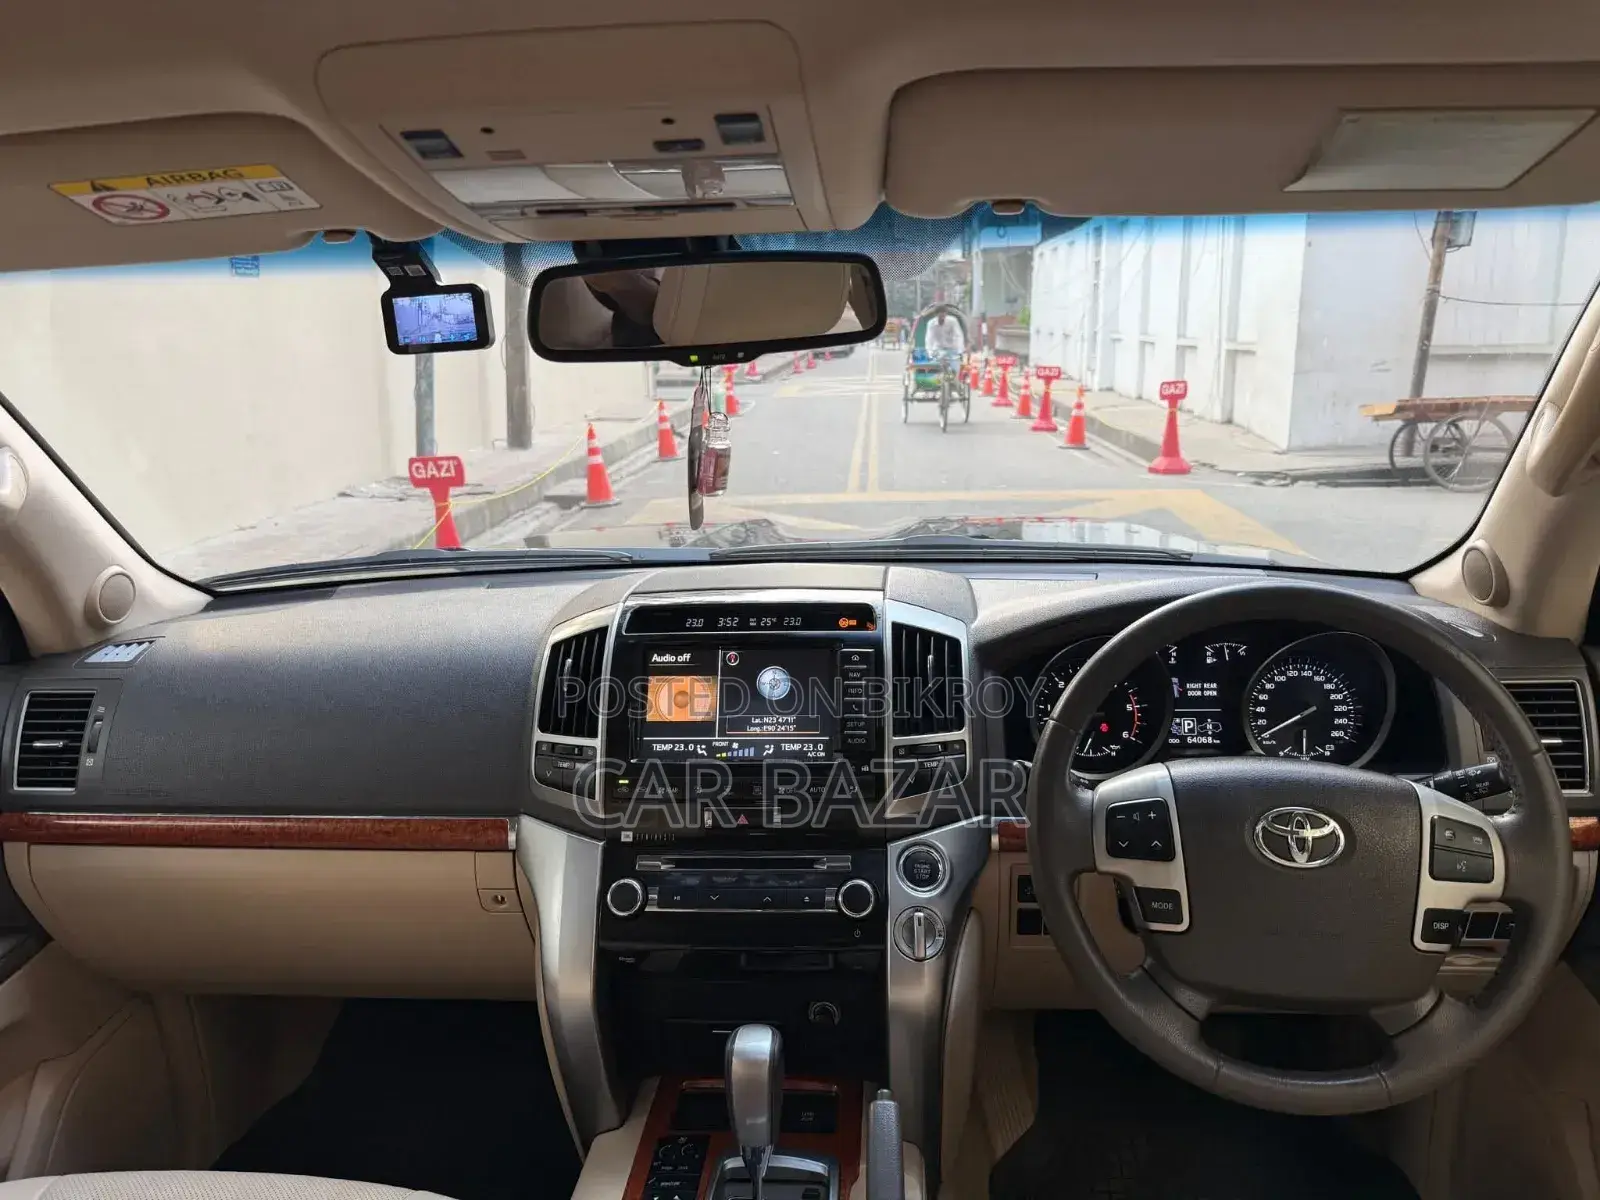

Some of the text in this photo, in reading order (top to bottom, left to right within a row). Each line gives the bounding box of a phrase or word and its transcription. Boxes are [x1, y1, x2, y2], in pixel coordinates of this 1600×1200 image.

[146, 168, 245, 188] AIRBAG
[411, 460, 457, 479] GAZI
[685, 618, 704, 627] 23.0
[717, 617, 739, 627] 3:52
[783, 617, 802, 626] 23.0
[652, 653, 692, 662] Audio off
[1184, 720, 1194, 733] P
[1187, 736, 1213, 744] 64068
[1151, 901, 1173, 910] MODE
[1433, 921, 1450, 930] DISP
